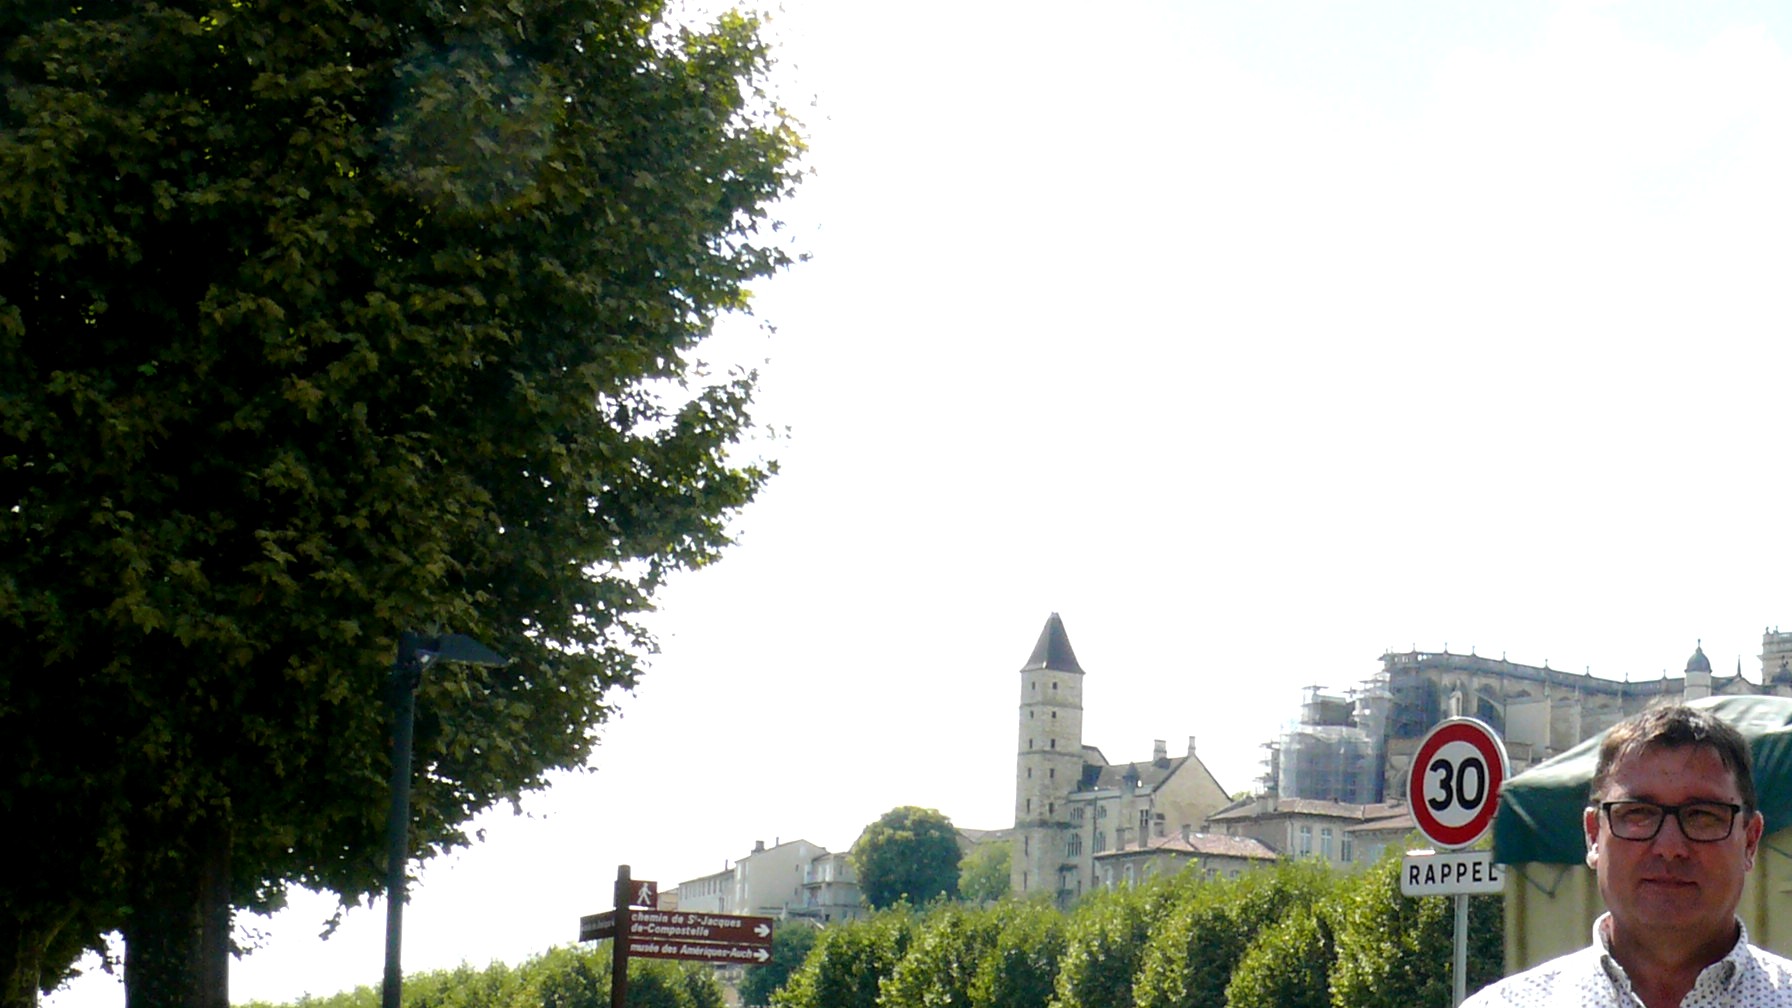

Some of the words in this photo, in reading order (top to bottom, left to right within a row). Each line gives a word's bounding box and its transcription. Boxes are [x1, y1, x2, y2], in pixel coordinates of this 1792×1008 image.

[1428, 757, 1486, 812] 30
[1409, 861, 1499, 886] RAPPEL
[631, 911, 668, 923] chemin
[671, 914, 684, 925] de
[630, 923, 710, 937] de-Compostelle
[630, 942, 660, 954] musée
[661, 944, 678, 955] des
